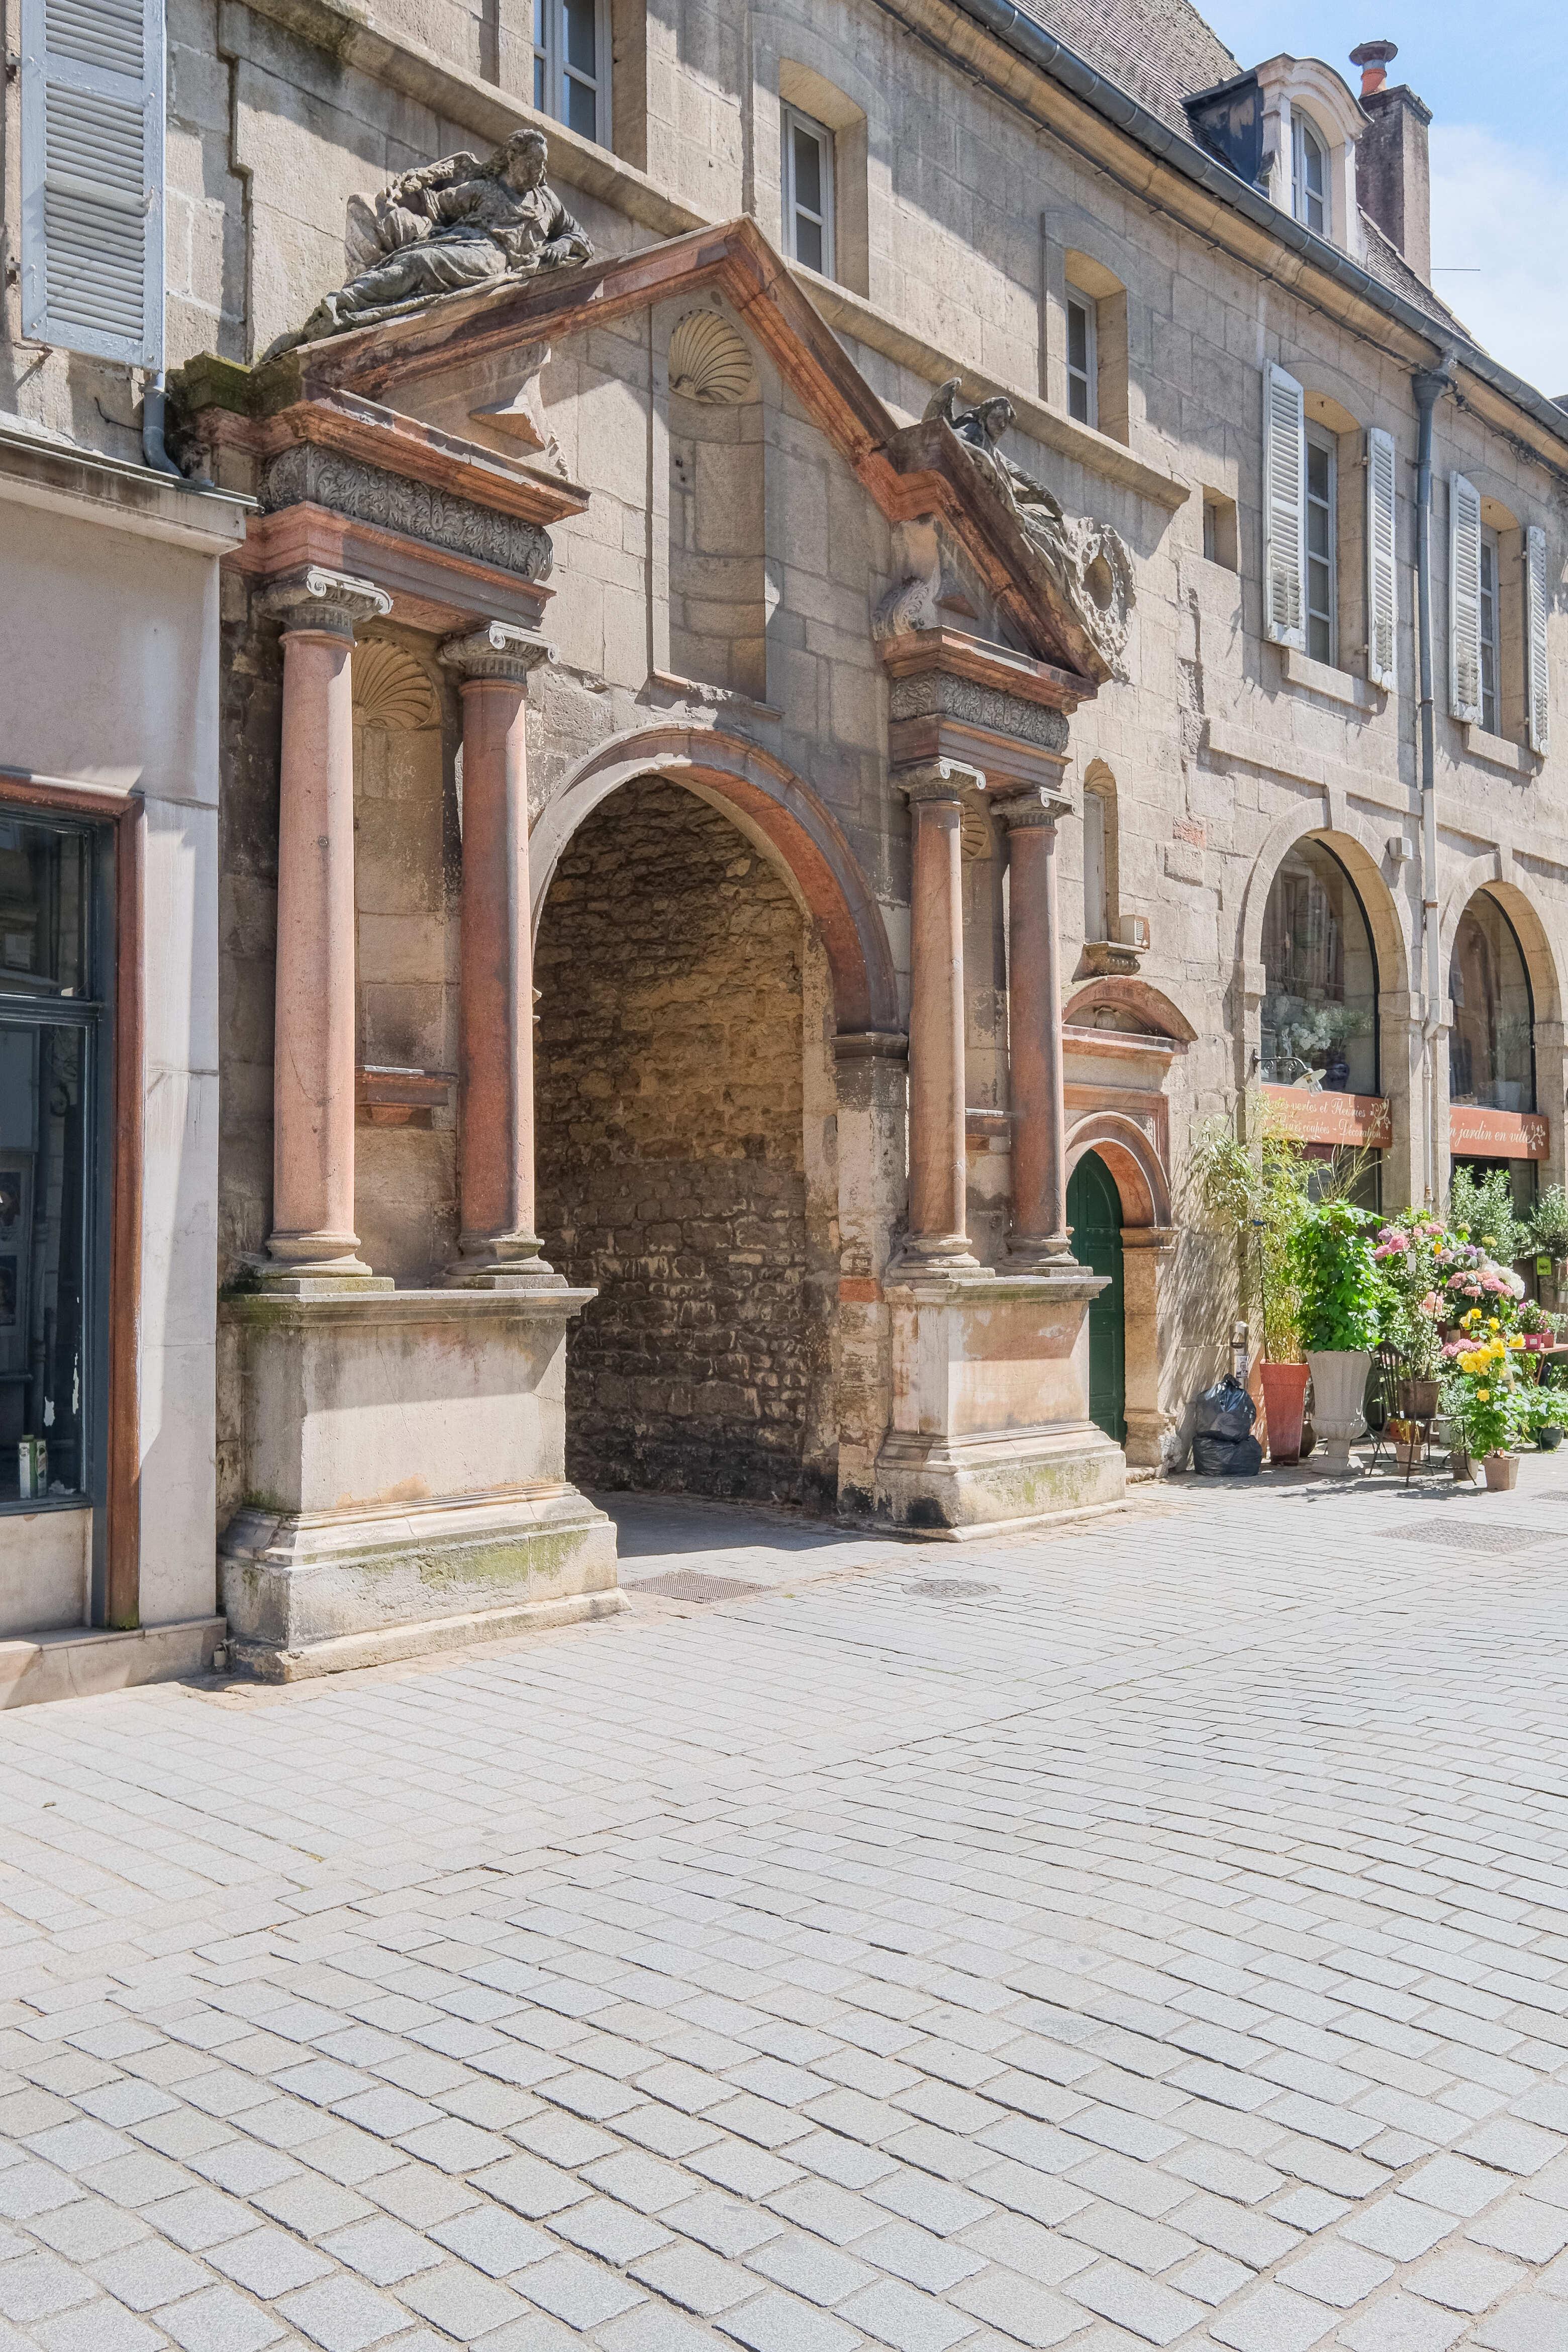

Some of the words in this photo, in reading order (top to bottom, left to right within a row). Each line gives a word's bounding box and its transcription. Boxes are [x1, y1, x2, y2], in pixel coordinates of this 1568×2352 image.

[1291, 1100, 1317, 1113] vertes
[1320, 1102, 1328, 1113] et
[1331, 1098, 1365, 1117] Fleuries
[1303, 1122, 1329, 1138] coupées
[1454, 1121, 1492, 1147] jardin
[1495, 1132, 1507, 1141] en
[1509, 1125, 1530, 1143] ville
